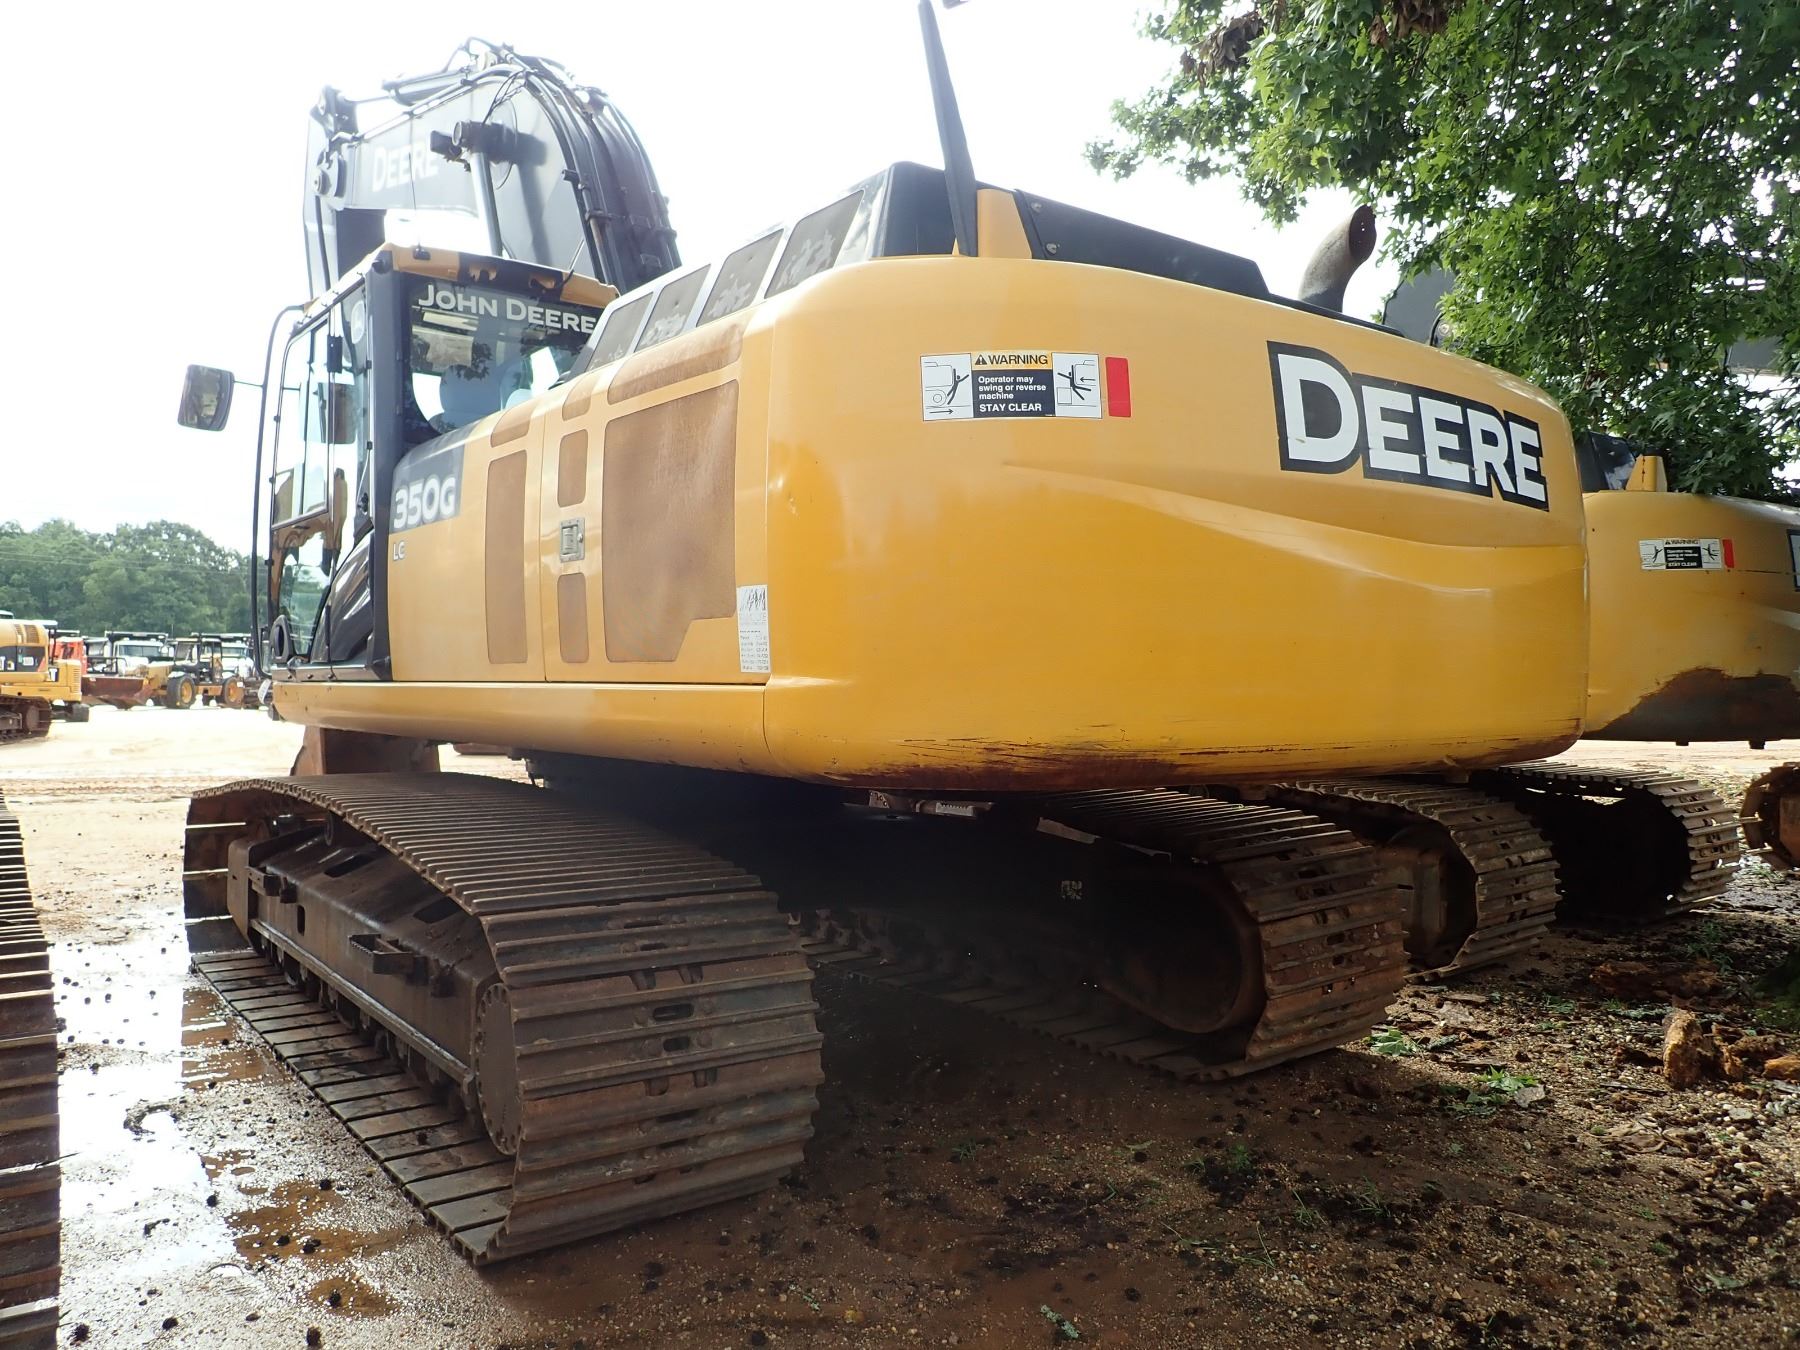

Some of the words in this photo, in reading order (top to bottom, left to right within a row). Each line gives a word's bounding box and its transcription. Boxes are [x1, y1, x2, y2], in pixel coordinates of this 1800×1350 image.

[372, 141, 440, 193] DEERE
[418, 284, 498, 317] JOHN
[506, 298, 597, 333] DEERE
[988, 354, 1048, 365] WARNING
[978, 376, 1015, 384] Operator
[1016, 376, 1034, 384] may
[979, 384, 1003, 392] swing
[979, 404, 1006, 412] STAY
[1008, 403, 1042, 412] CLEAR
[1277, 353, 1546, 502] DEERE
[393, 477, 456, 529] 350G
[393, 541, 405, 560] LC
